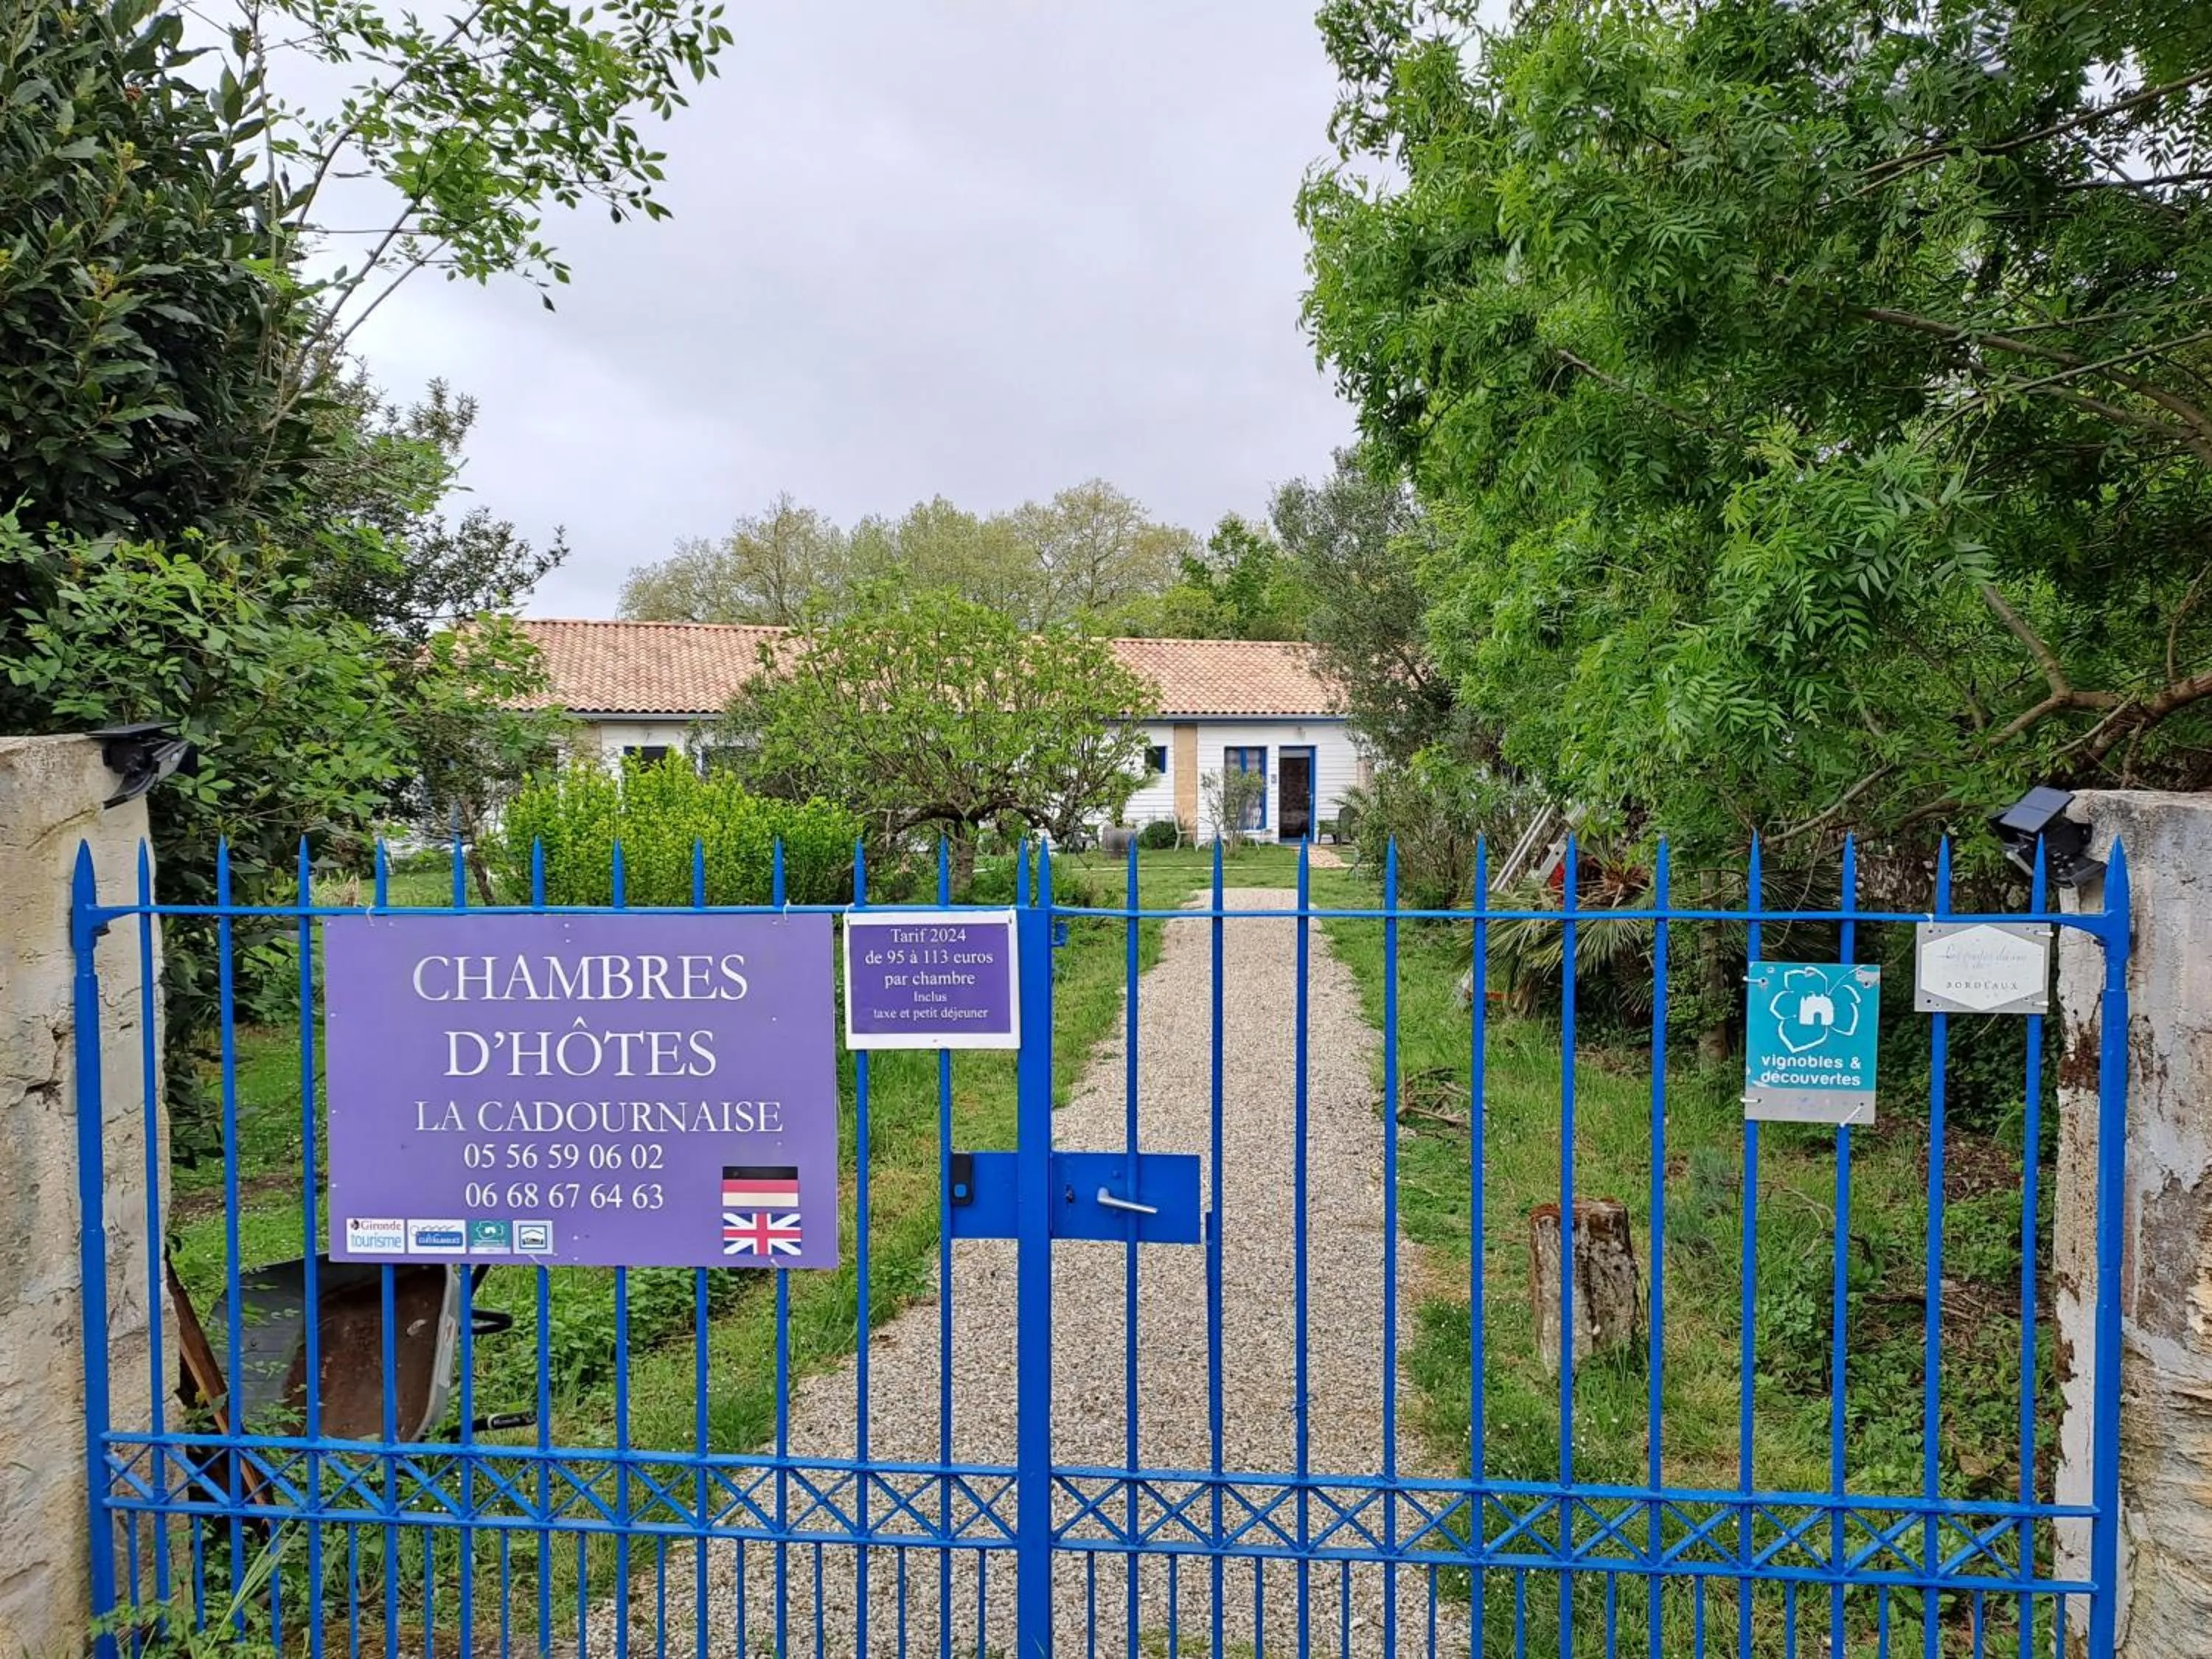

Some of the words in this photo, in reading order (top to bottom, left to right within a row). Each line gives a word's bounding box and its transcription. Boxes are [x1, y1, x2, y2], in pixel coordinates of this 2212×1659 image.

[891, 928, 926, 943] Tarif
[931, 928, 967, 943] 2024
[865, 950, 883, 964] de
[887, 950, 905, 964] 95
[909, 950, 918, 964] à
[924, 950, 948, 964] 113
[953, 953, 994, 964] euros
[412, 954, 748, 1001] CHAMBRES
[885, 974, 907, 989] par
[912, 971, 975, 985] chambre
[914, 991, 947, 1003] Inclus
[873, 1008, 897, 1019] taxe
[900, 1008, 910, 1018] et
[913, 1007, 938, 1021] petit
[940, 1007, 989, 1021] déjeuner
[443, 1015, 717, 1077] D'HÔTES
[1761, 1054, 1843, 1069] vignobles
[1850, 1057, 1862, 1069] &
[1761, 1071, 1862, 1086] découvertes
[414, 1101, 465, 1133] LA
[478, 1100, 784, 1133] CADOURNAISE
[464, 1144, 495, 1169] 05
[507, 1144, 538, 1169] 56
[548, 1144, 580, 1169] 59
[589, 1144, 622, 1169] 06
[631, 1144, 664, 1169] 02
[465, 1183, 497, 1208] 06
[507, 1183, 539, 1208] 68
[548, 1183, 580, 1208] 67
[590, 1183, 623, 1208] 64
[632, 1183, 664, 1209] 63
[361, 1220, 402, 1230] Gironde
[350, 1233, 402, 1248] tourisme
